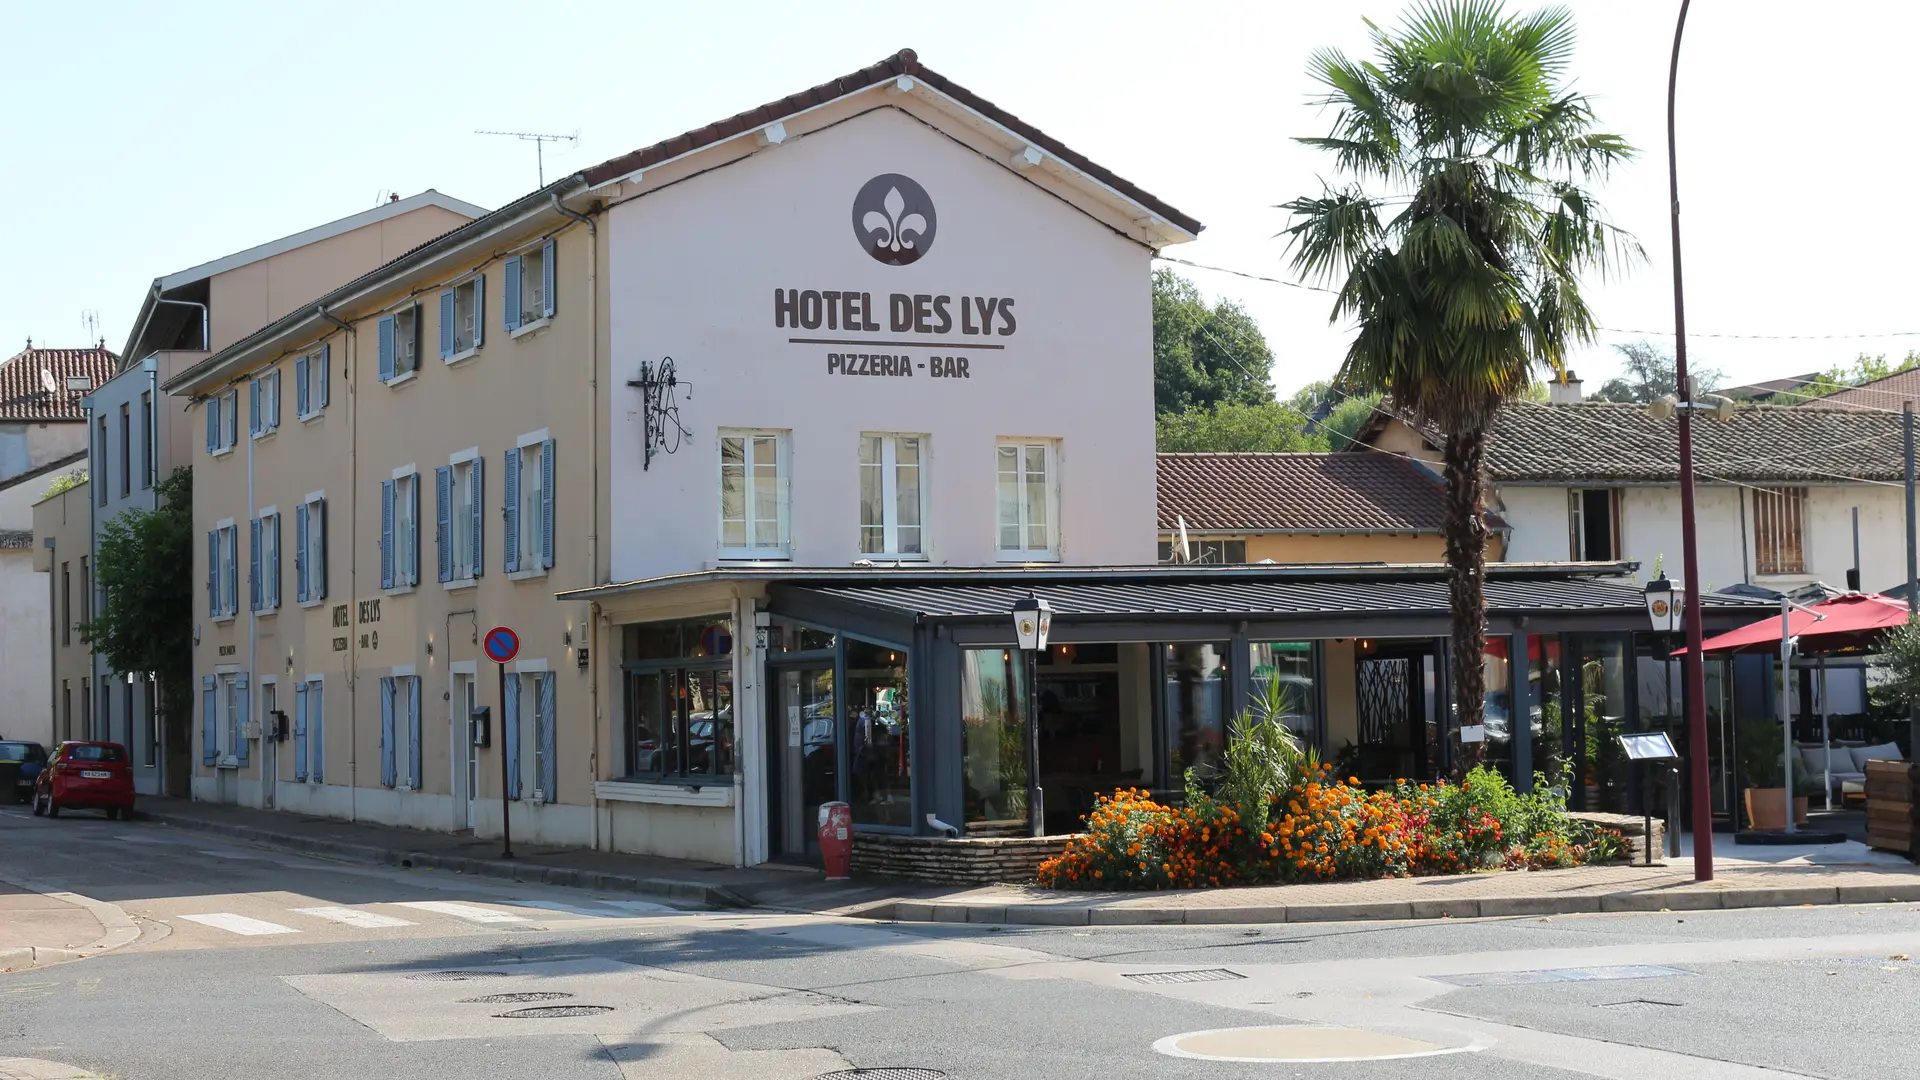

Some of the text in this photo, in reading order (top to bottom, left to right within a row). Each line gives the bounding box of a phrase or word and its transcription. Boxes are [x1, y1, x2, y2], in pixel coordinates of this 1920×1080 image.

[774, 288, 1017, 336] HOTEL DES LYS
[827, 352, 913, 377] PIZZERIA
[930, 356, 970, 378] BAR
[333, 599, 380, 627] HOTEL DES LYS
